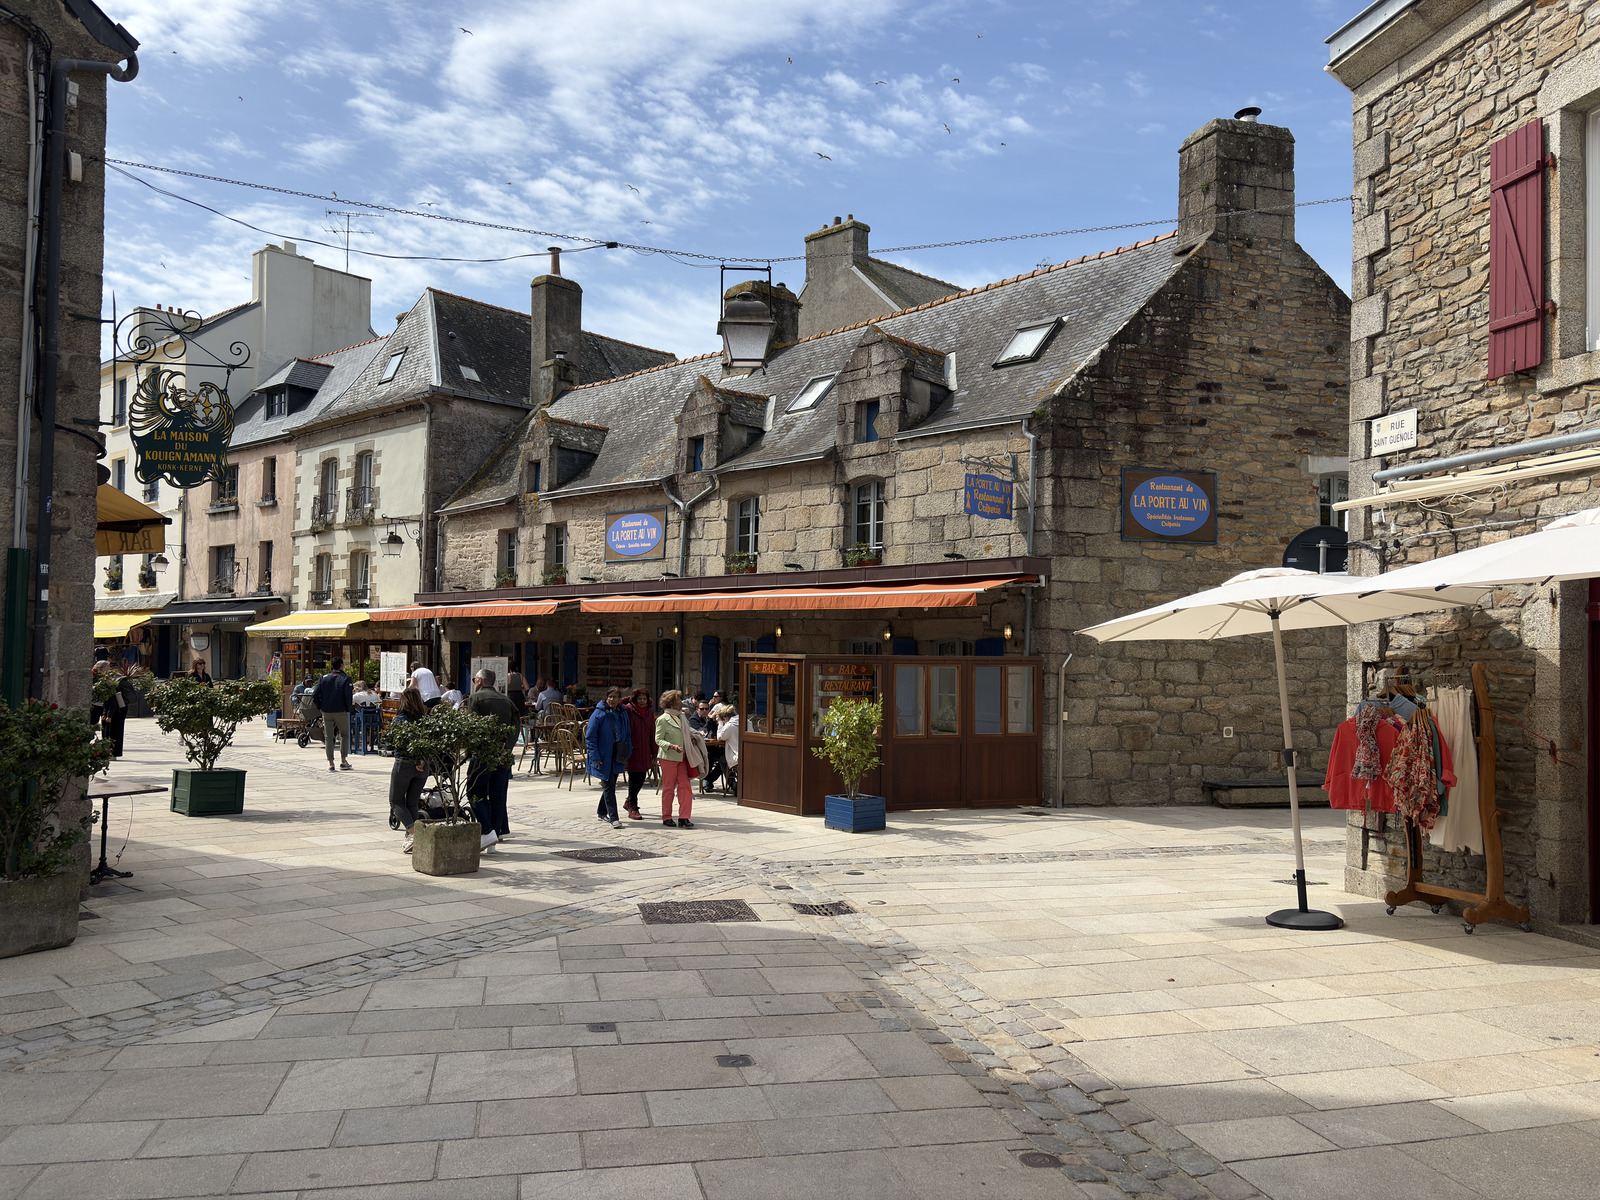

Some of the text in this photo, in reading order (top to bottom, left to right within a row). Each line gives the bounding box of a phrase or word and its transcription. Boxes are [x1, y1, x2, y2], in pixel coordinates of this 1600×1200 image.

[1390, 419, 1405, 431] RUE
[154, 430, 209, 442] LA MAISON
[1374, 429, 1413, 448] SAINT GUÉNOLÉ
[174, 442, 188, 451] DU
[145, 450, 217, 463] KOUIGN AMANN
[157, 463, 203, 472] KONK-KERNE
[966, 476, 975, 487] LA
[975, 477, 993, 491] PORTE
[994, 481, 1001, 492] AU
[1149, 481, 1194, 493] Restaurant de
[1133, 494, 1207, 511] LA PORTE AU VIN
[612, 528, 656, 542] LA PORTE AU VIN
[761, 663, 777, 674] BAR
[838, 664, 857, 675] BAR
[823, 680, 872, 692] RESTAURANT
